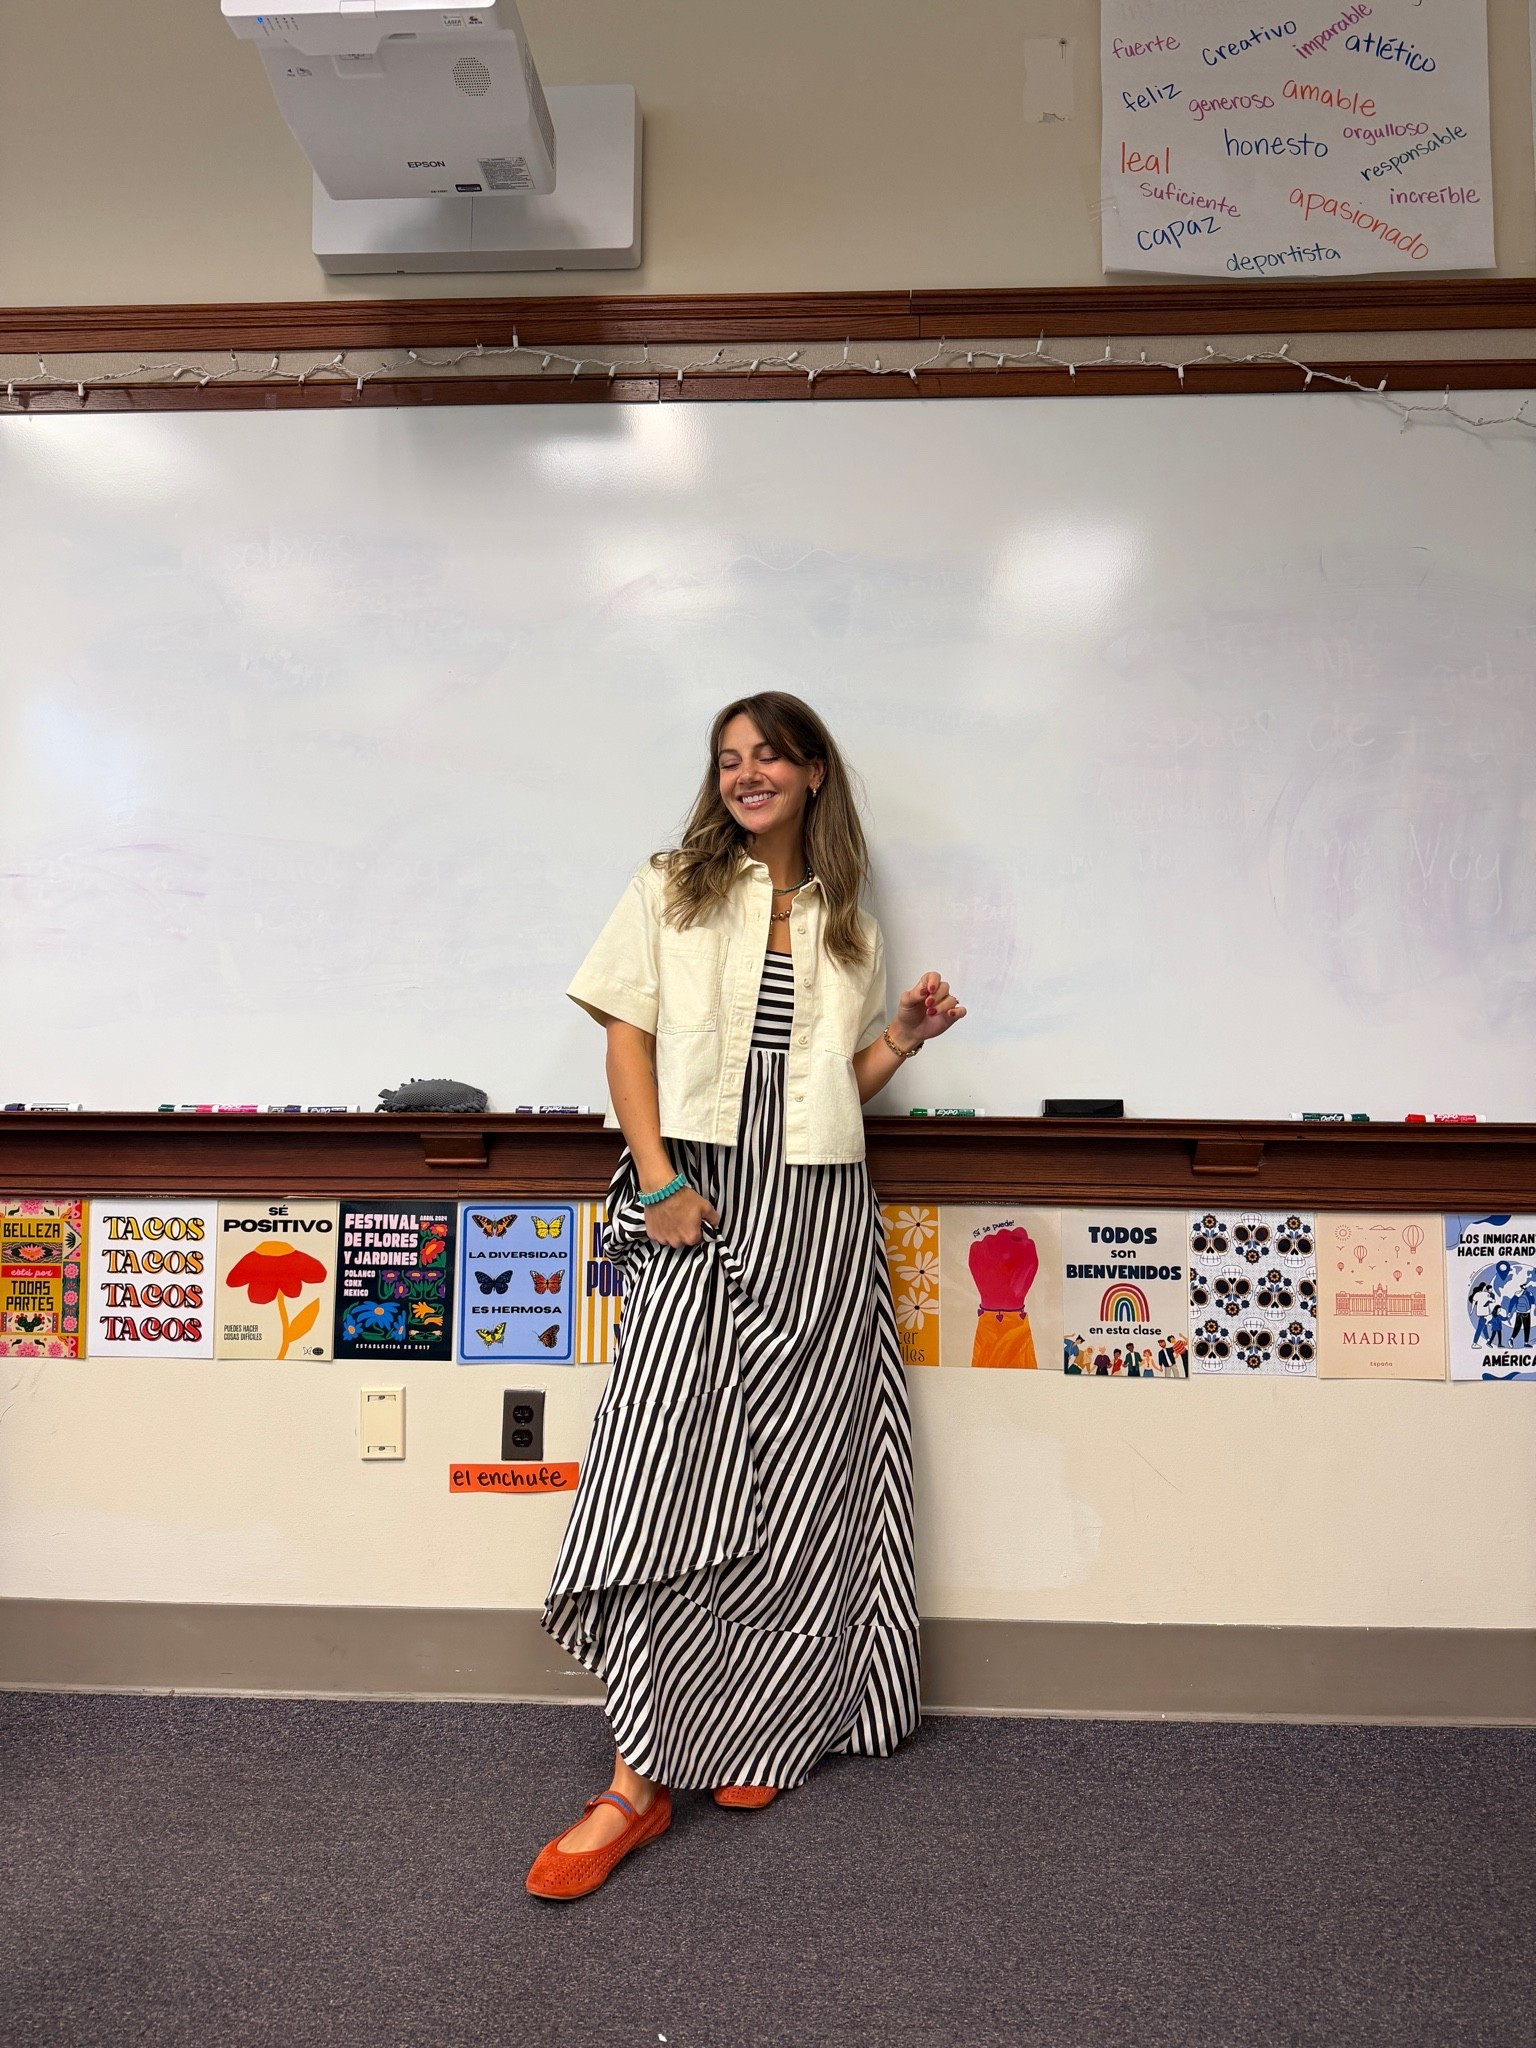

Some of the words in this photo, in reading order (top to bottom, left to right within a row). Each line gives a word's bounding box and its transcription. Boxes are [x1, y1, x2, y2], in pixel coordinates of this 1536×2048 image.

[1292, 3, 1372, 59] imparable
[1112, 35, 1181, 59] fuerte
[1345, 32, 1436, 72] atlético
[1122, 83, 1182, 112] feliz
[1282, 80, 1376, 116] amable
[1188, 94, 1275, 121] generoso
[1224, 128, 1328, 157] honesto
[1343, 122, 1429, 146] orgulloso
[1121, 141, 1170, 174] leal
[1360, 125, 1468, 181] responsable
[407, 160, 446, 169] EPSON
[1140, 182, 1241, 217] suficiente
[1389, 186, 1481, 205] increíble
[1289, 188, 1429, 260] apasionado
[1137, 216, 1222, 251] capaz
[1226, 243, 1341, 274] deportista
[937, 1109, 959, 1117] EXPO
[268, 1204, 289, 1216] SÉ
[3, 1223, 60, 1238] BELLEZA
[102, 1216, 205, 1241] TACOS
[223, 1219, 333, 1233] POSITIVO
[344, 1213, 419, 1230] FESTIVAL
[343, 1232, 362, 1247] DE
[364, 1232, 419, 1248] FLORES
[1088, 1226, 1158, 1245] TODOS
[1460, 1233, 1480, 1244] LOS
[1483, 1233, 1536, 1244] INMIGRAN
[343, 1250, 352, 1265] Y
[354, 1251, 418, 1266] JARDINES
[469, 1251, 486, 1259] LA
[488, 1251, 568, 1259] DIVERSIDAD
[1110, 1249, 1137, 1259] son
[1457, 1246, 1495, 1257] HACEN
[101, 1249, 204, 1274] TACOS
[34, 1269, 53, 1278] por
[1066, 1264, 1182, 1280] BIENVENIDOS
[11, 1280, 50, 1295] TODAS
[100, 1283, 203, 1309] TACOS
[6, 1296, 54, 1311] PARTES
[472, 1306, 489, 1314] ES
[491, 1306, 562, 1314] HERMOSA
[99, 1316, 202, 1342] TACOS
[223, 1333, 240, 1341] COSAS
[224, 1324, 242, 1332] PUEDES
[243, 1324, 259, 1332] HACER
[1089, 1327, 1103, 1335] en
[1106, 1326, 1130, 1335] esta
[1133, 1324, 1162, 1335] clase
[1342, 1332, 1420, 1346] MADRID
[452, 1469, 471, 1487] el
[476, 1467, 568, 1488] enchufe
